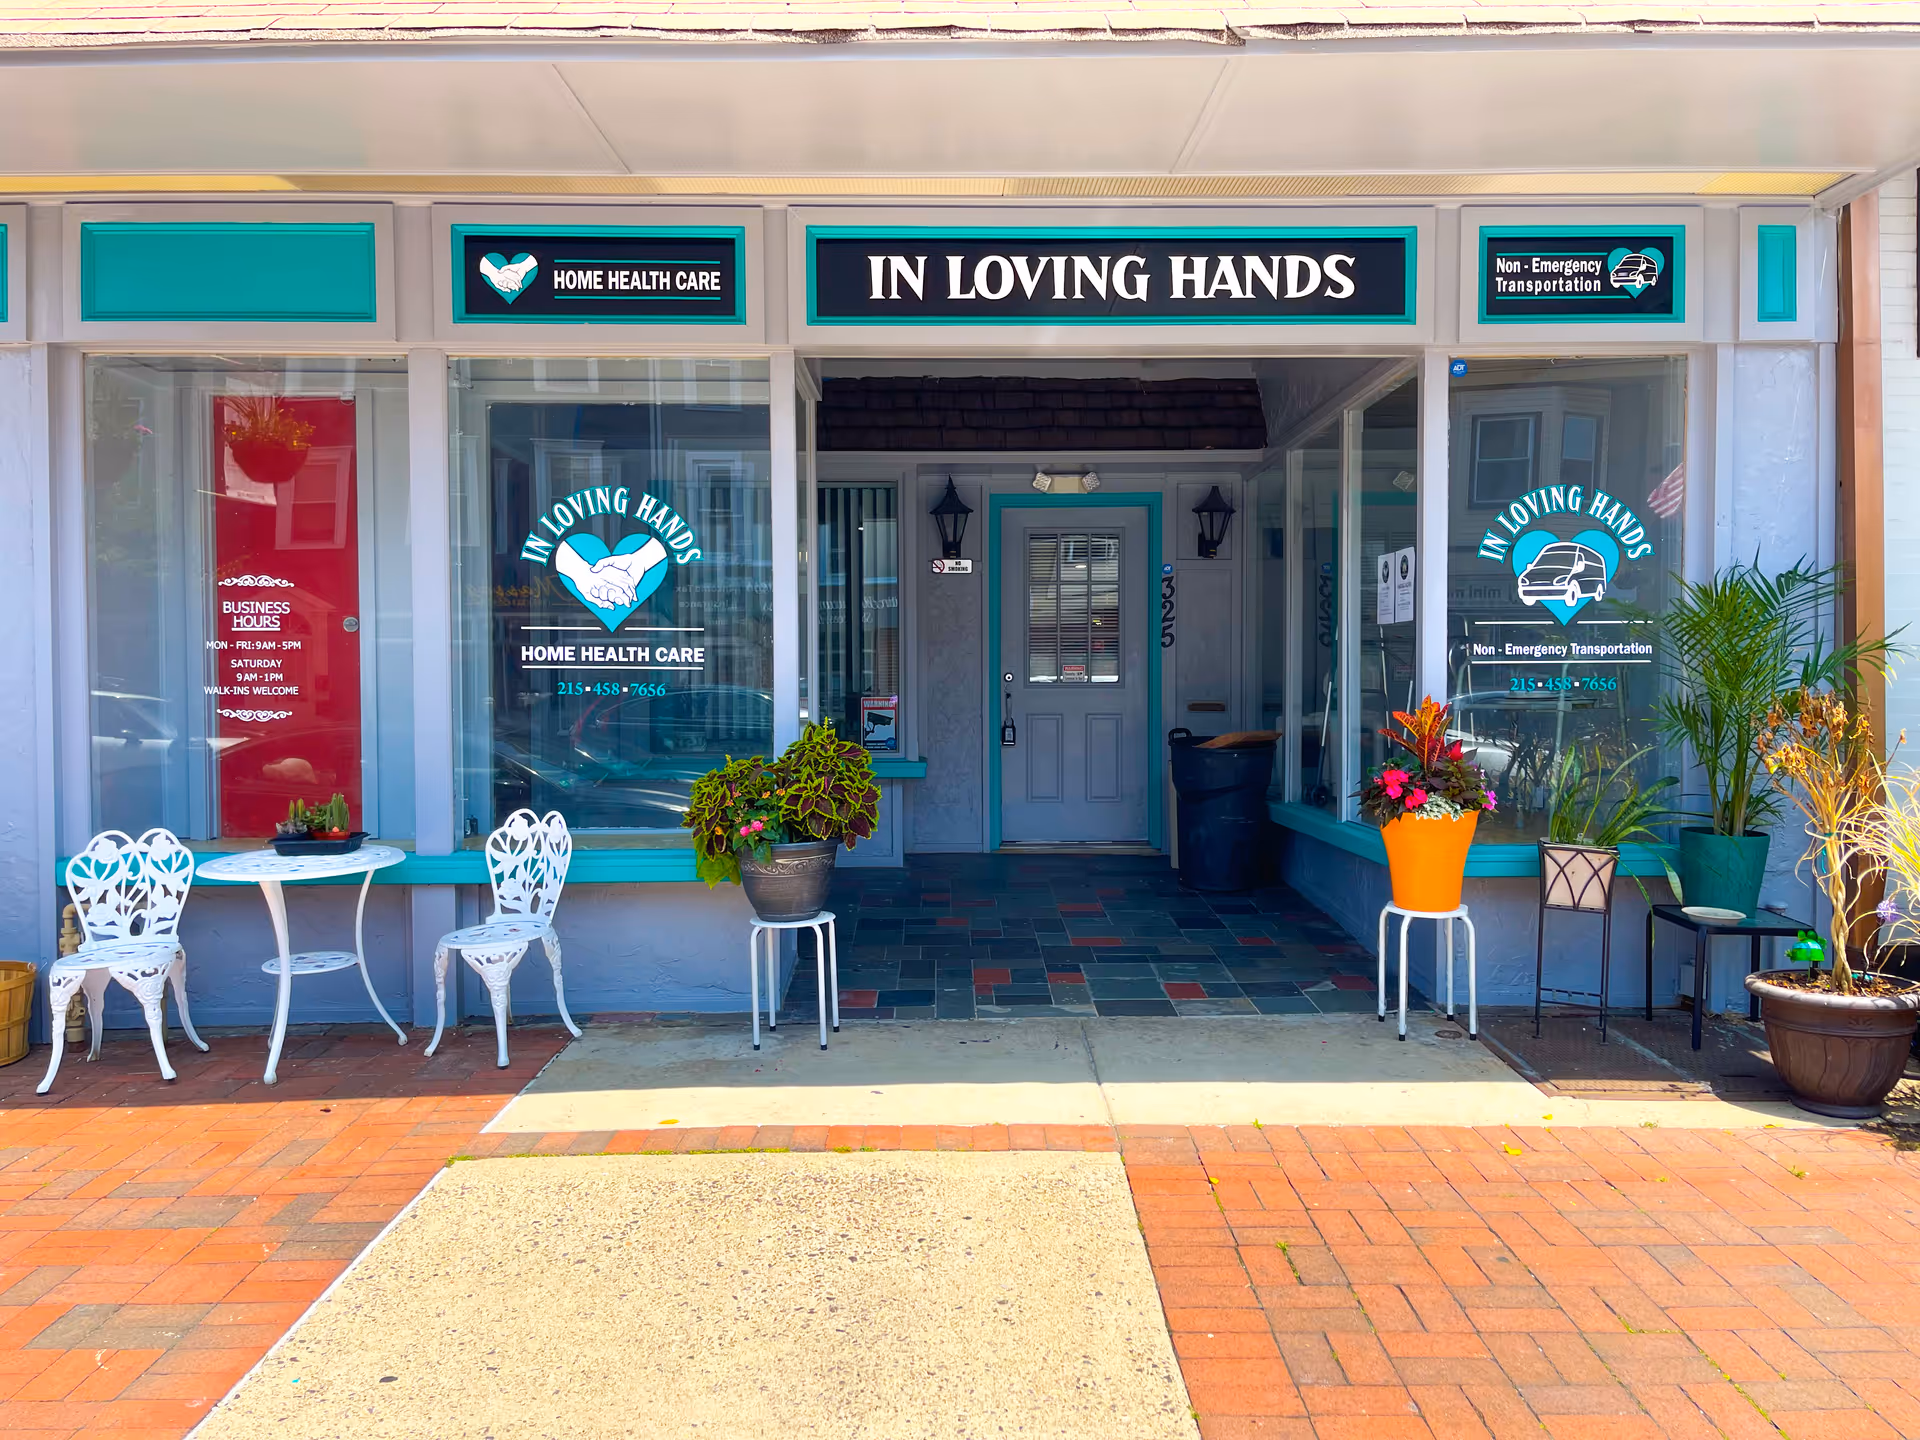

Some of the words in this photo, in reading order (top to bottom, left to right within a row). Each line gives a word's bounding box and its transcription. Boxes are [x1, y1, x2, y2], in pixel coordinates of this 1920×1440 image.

[1496, 257, 1521, 273] Non
[1532, 257, 1602, 276] Emergency
[553, 270, 604, 290] HOME
[608, 270, 671, 290] HEALTH
[675, 271, 721, 291] CARE
[867, 255, 927, 301] IN
[946, 254, 1151, 302] LOVING
[1168, 254, 1356, 300] HANDS
[1495, 276, 1601, 295] Transportation
[1494, 484, 1584, 538] LOVING
[520, 530, 555, 567] IN
[538, 485, 631, 540] LOVING
[632, 491, 704, 566] HANDS
[1585, 488, 1655, 561] HANDS
[1477, 528, 1512, 564] IN
[222, 601, 291, 614] BUSINESS
[1161, 575, 1175, 648] 325
[233, 615, 281, 628] HOURS
[206, 641, 228, 650] MON
[521, 646, 576, 662] HOME
[581, 646, 650, 662] HEALTH
[655, 647, 705, 663] CARE
[1473, 643, 1496, 656] Non
[1505, 643, 1568, 657] Emergency
[1570, 642, 1653, 657] Transportation
[230, 659, 283, 668] SATURDAY
[203, 686, 250, 695] WALK-INS
[252, 686, 299, 695] WELCOME
